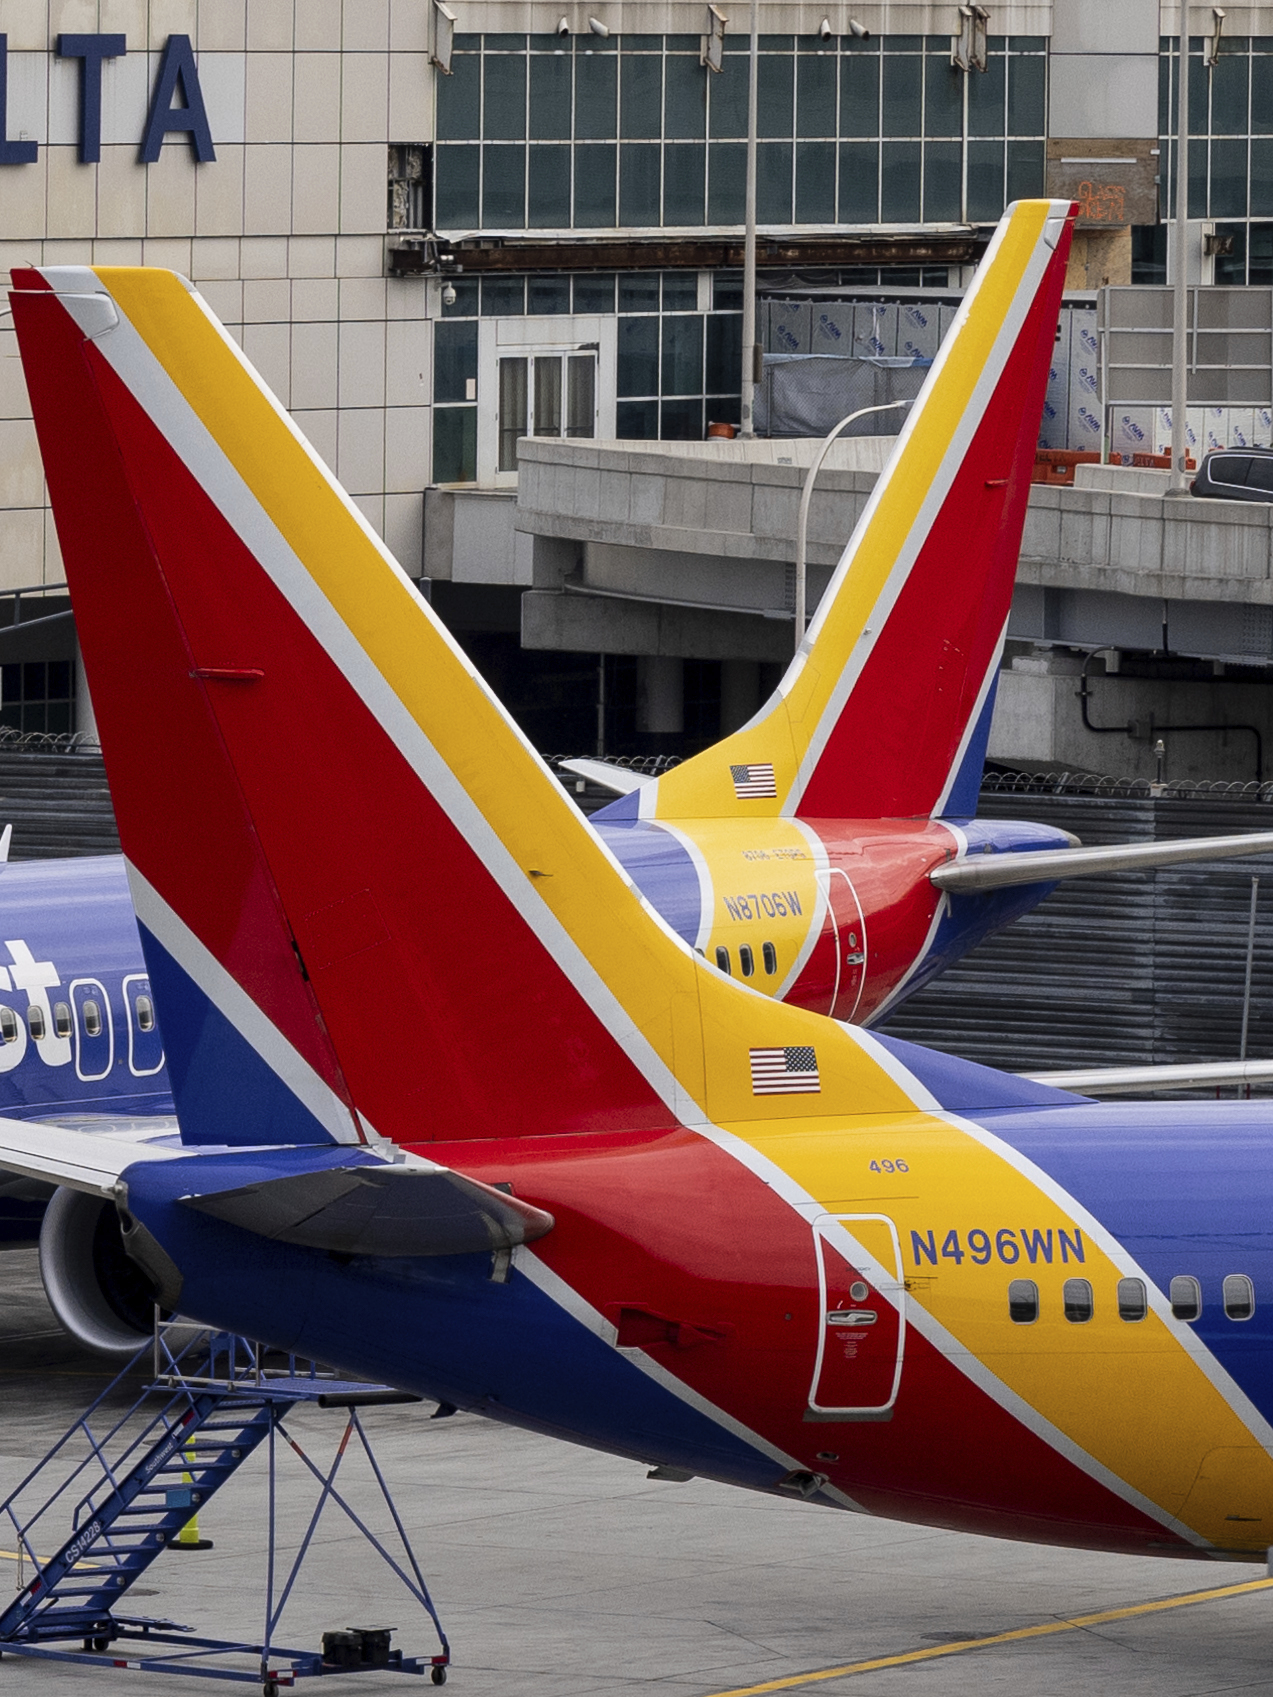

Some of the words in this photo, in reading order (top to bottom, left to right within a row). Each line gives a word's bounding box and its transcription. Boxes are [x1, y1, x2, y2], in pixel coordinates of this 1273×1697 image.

[723, 891, 802, 921] N8706W
[869, 1158, 909, 1174] 496
[910, 1228, 1086, 1266] N496WN
[145, 1442, 174, 1474] Southwest
[65, 1521, 101, 1563] CS14228
